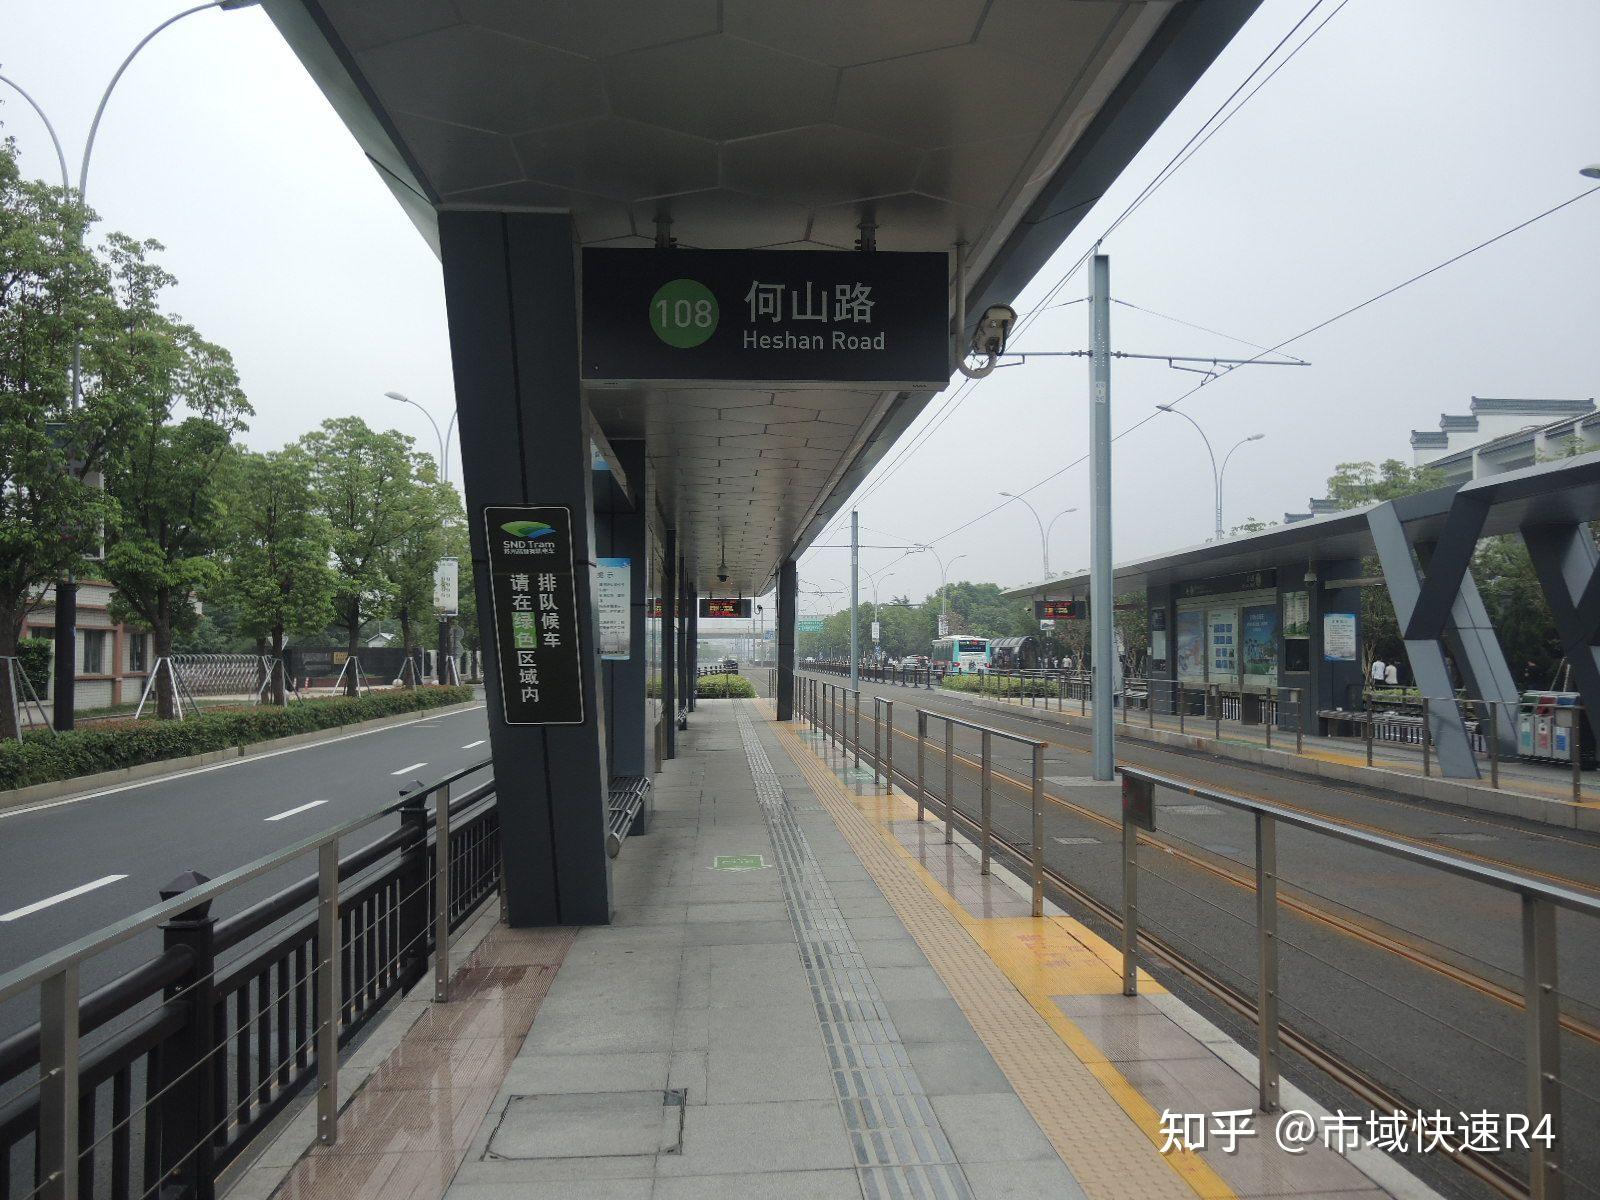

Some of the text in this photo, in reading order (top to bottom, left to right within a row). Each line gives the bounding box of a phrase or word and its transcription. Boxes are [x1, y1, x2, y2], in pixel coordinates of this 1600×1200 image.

[656, 299, 713, 328] 108
[744, 280, 876, 323] 何山路
[743, 330, 885, 350] Heshan Road
[503, 540, 556, 549] SND Tram
[538, 573, 562, 648] 排队候车
[510, 573, 540, 703] 请在绿色区域内
